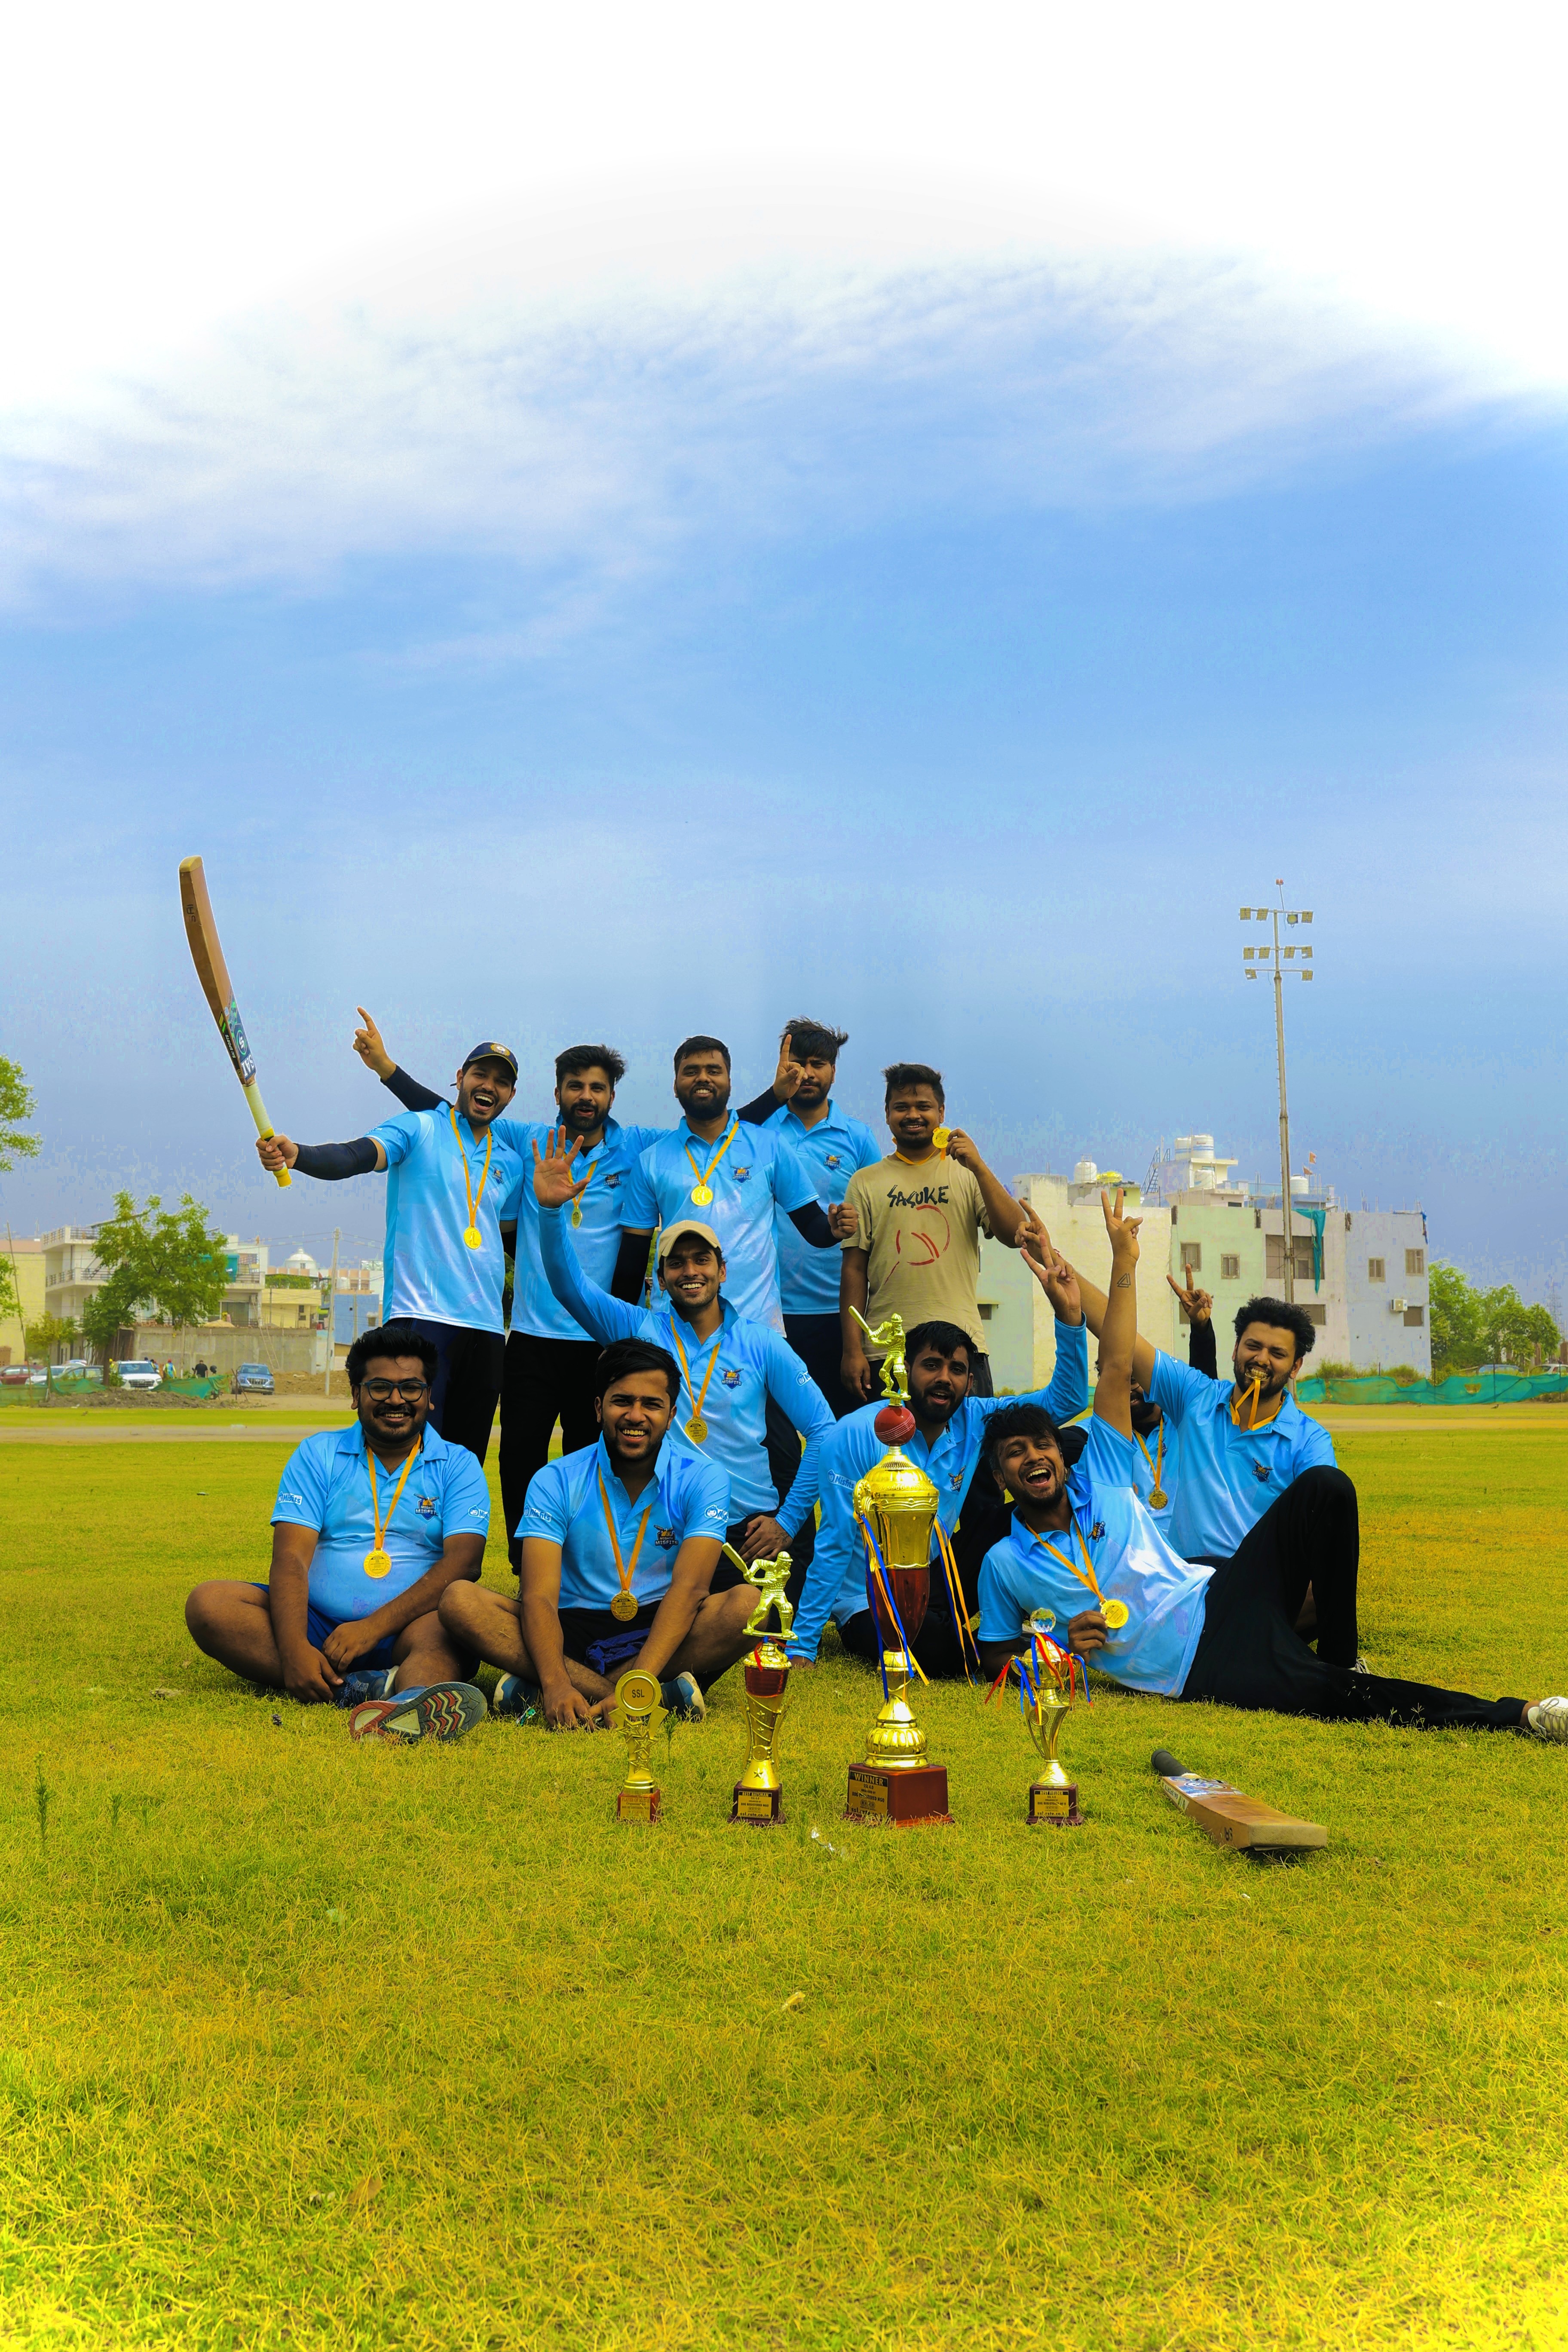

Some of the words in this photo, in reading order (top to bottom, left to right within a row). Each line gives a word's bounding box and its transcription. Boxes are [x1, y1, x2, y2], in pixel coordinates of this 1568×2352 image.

[187, 904, 196, 922] SAI
[225, 1035, 233, 1051] SPORTS
[242, 1054, 254, 1076] SAI
[887, 1185, 949, 1208] SASUKE
[835, 1476, 854, 1489] Misfits
[632, 1689, 645, 1698] SSL
[854, 1773, 883, 1785] WINNER
[1224, 1827, 1233, 1841] SAI
